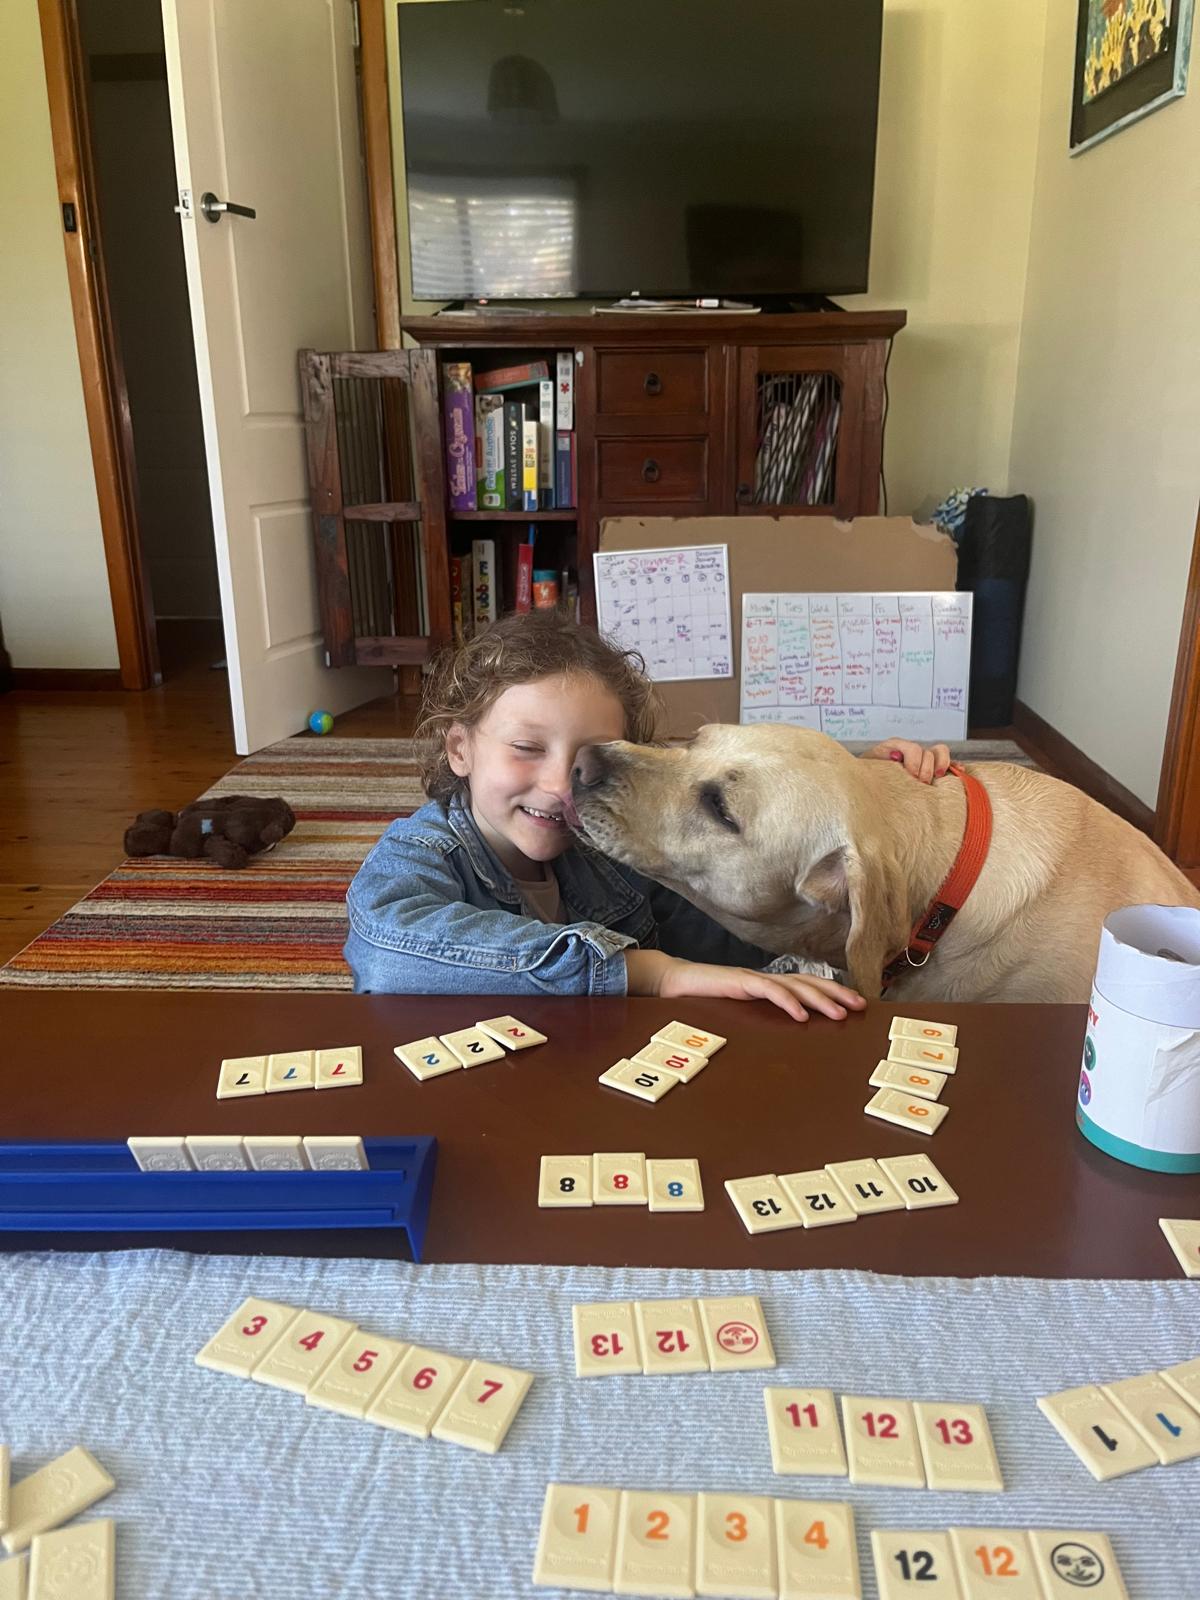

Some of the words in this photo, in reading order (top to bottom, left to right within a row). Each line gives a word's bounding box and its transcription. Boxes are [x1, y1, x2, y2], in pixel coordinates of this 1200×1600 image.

[510, 459, 518, 490] SYSTEM
[507, 1028, 525, 1037] 2
[685, 1033, 709, 1048] 10
[923, 1028, 942, 1037] 6
[467, 1042, 484, 1053] 2
[923, 1051, 943, 1061] 7
[422, 1054, 439, 1065] 2
[666, 1055, 689, 1068] 10
[283, 1068, 297, 1079] 7
[332, 1064, 345, 1075] 7
[236, 1073, 250, 1085] 7
[635, 1073, 659, 1087] 10
[909, 1075, 929, 1086] 8
[908, 1105, 928, 1117] 9
[560, 1178, 575, 1192] 8
[614, 1175, 628, 1189] 8
[668, 1182, 683, 1196] 8
[855, 1182, 883, 1198] 11
[908, 1177, 938, 1193] 10
[753, 1199, 781, 1216] 13
[805, 1194, 836, 1210] 12
[243, 1316, 267, 1336] 3
[299, 1331, 324, 1351] 4
[591, 1334, 623, 1356] 13
[656, 1330, 689, 1353] 12
[353, 1350, 378, 1372] 5
[413, 1368, 437, 1389] 6
[478, 1380, 503, 1403] 7
[786, 1404, 818, 1427] 11
[862, 1413, 898, 1438] 12
[936, 1419, 973, 1445] 13
[1156, 1413, 1181, 1437] 1
[1092, 1425, 1118, 1451] 1
[575, 1505, 588, 1533] 1
[646, 1512, 668, 1539] 2
[726, 1513, 746, 1541] 3
[804, 1522, 828, 1549] 4
[895, 1550, 937, 1581] 12
[976, 1547, 1017, 1576] 12
